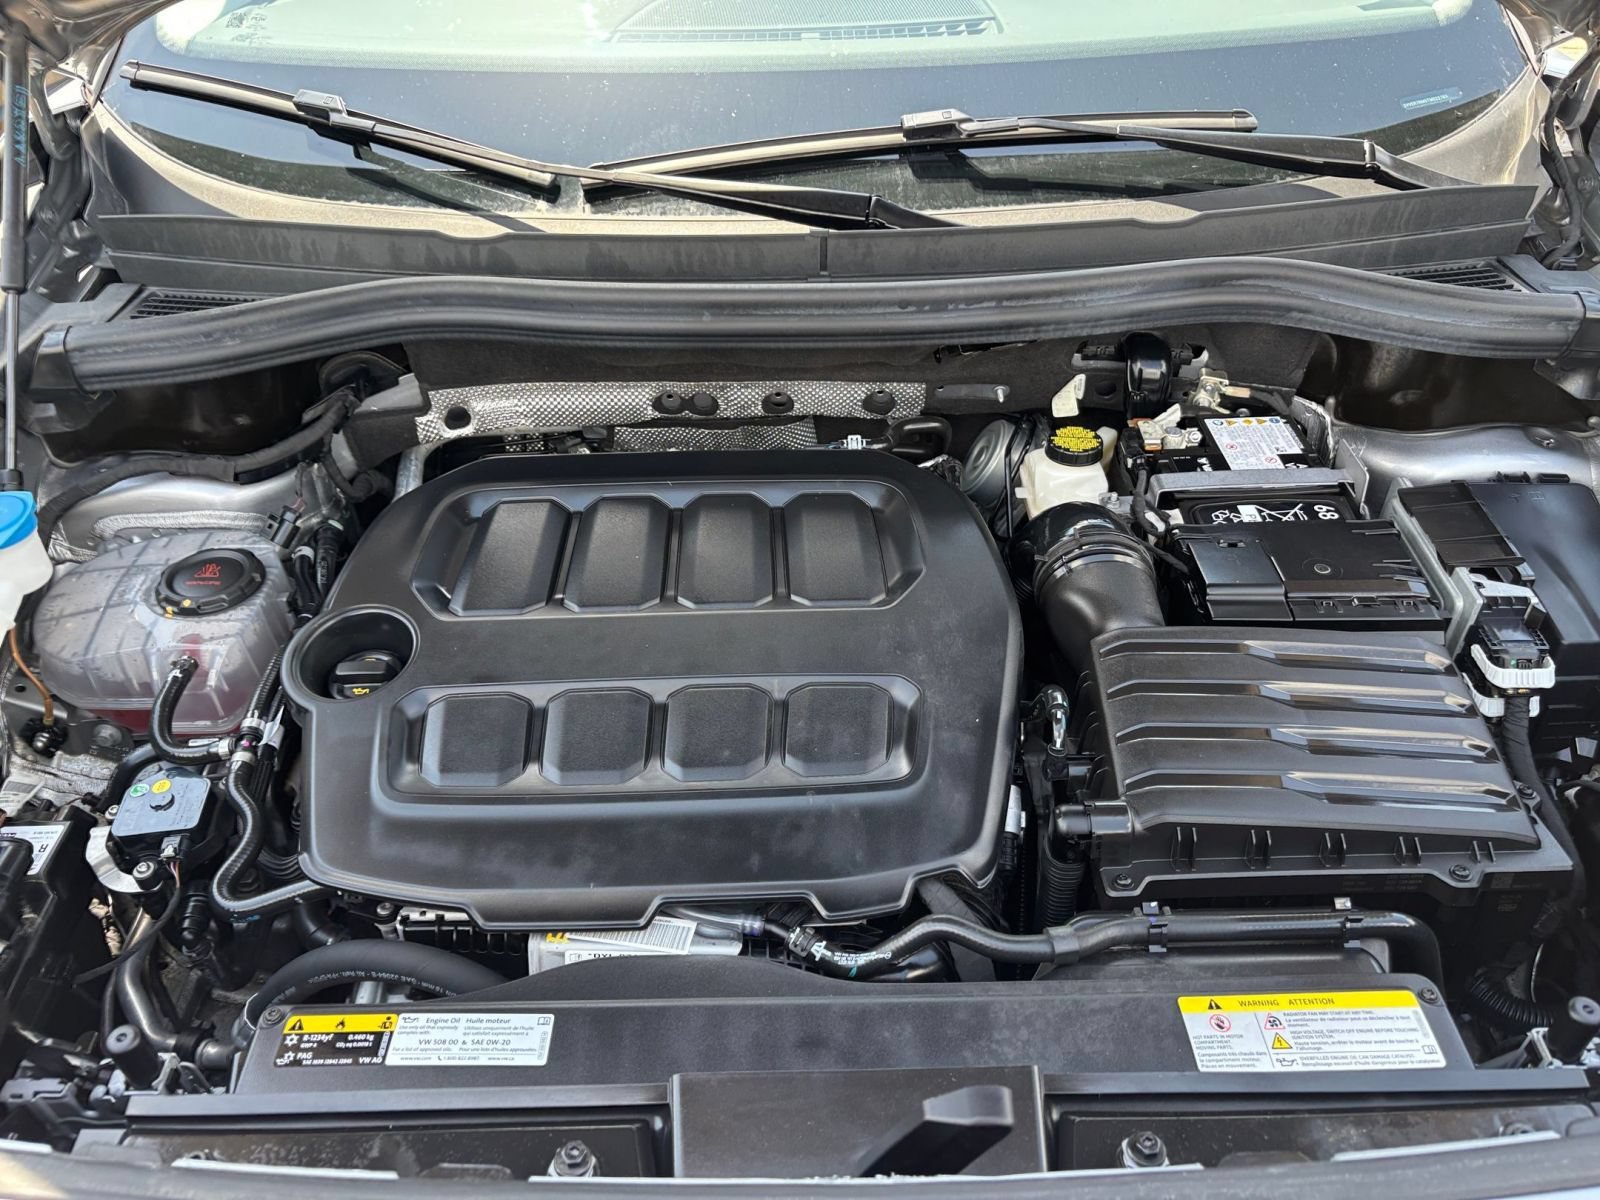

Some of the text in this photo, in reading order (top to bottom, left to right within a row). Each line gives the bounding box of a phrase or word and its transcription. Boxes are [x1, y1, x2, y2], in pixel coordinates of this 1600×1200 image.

[1238, 997, 1336, 1008] WARNING ATTENTION
[426, 1017, 450, 1025] Engine
[302, 1034, 334, 1043] R-1234yf
[366, 1034, 375, 1042] kg
[296, 1052, 312, 1060] PAG
[359, 1056, 372, 1064] VW
